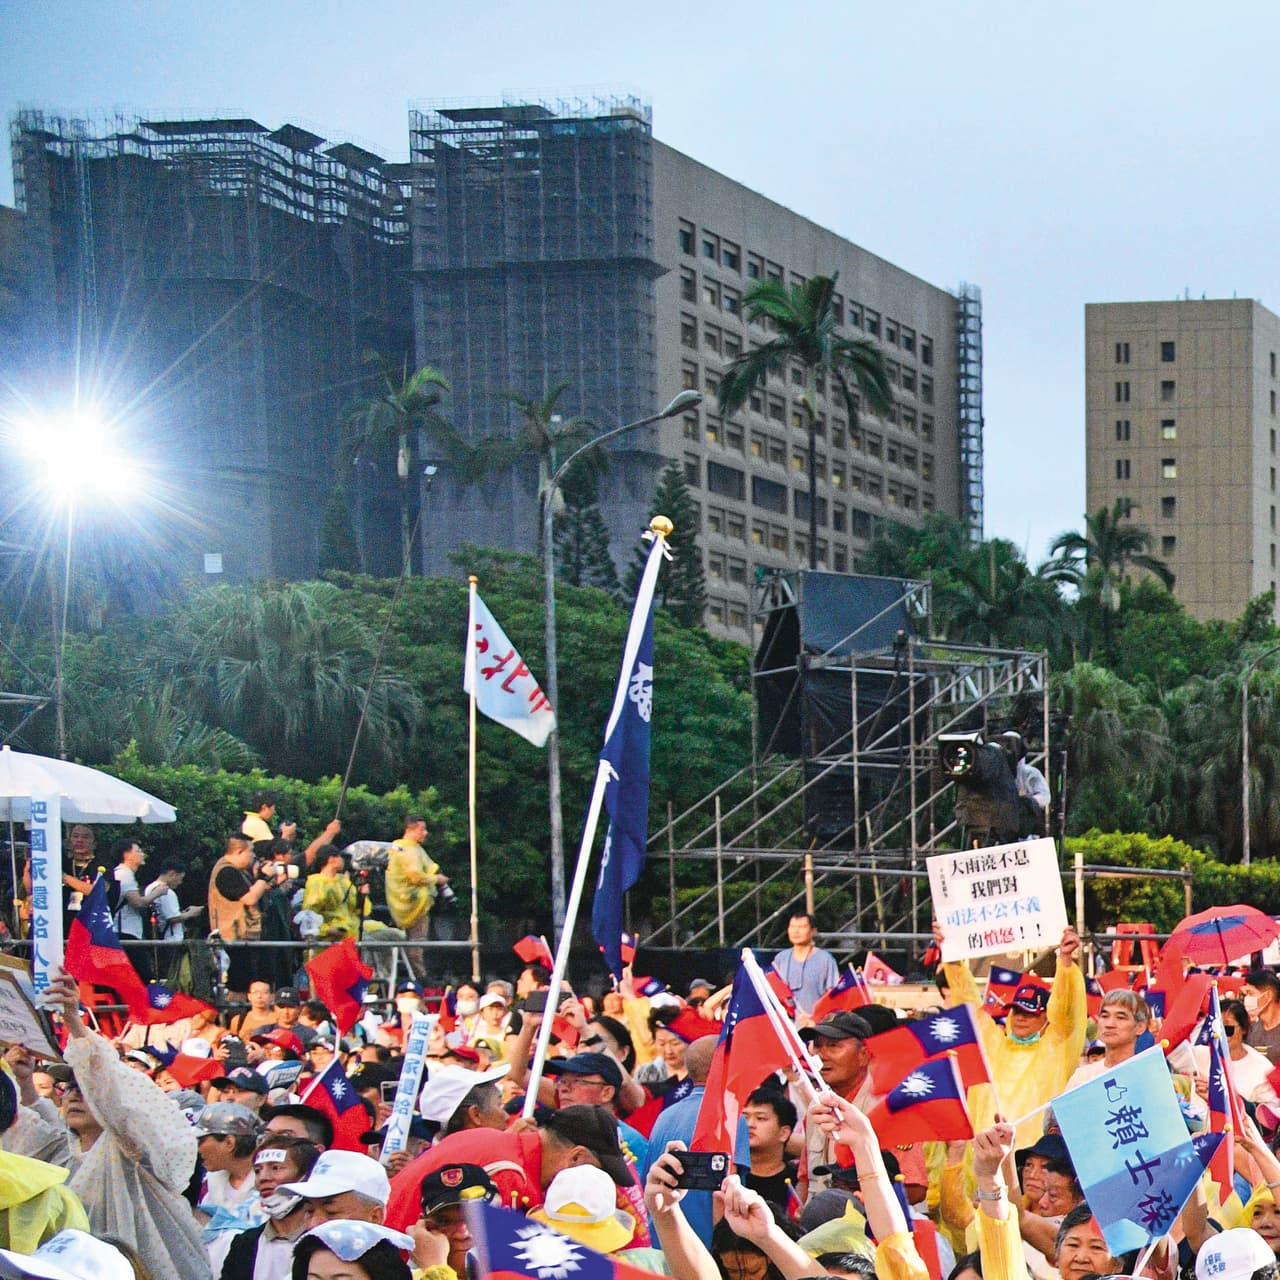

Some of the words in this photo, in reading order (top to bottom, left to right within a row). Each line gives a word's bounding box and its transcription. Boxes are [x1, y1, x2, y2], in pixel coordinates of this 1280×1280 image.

[971, 875, 1018, 899] 我們對
[946, 896, 1041, 927] 司法不公不義
